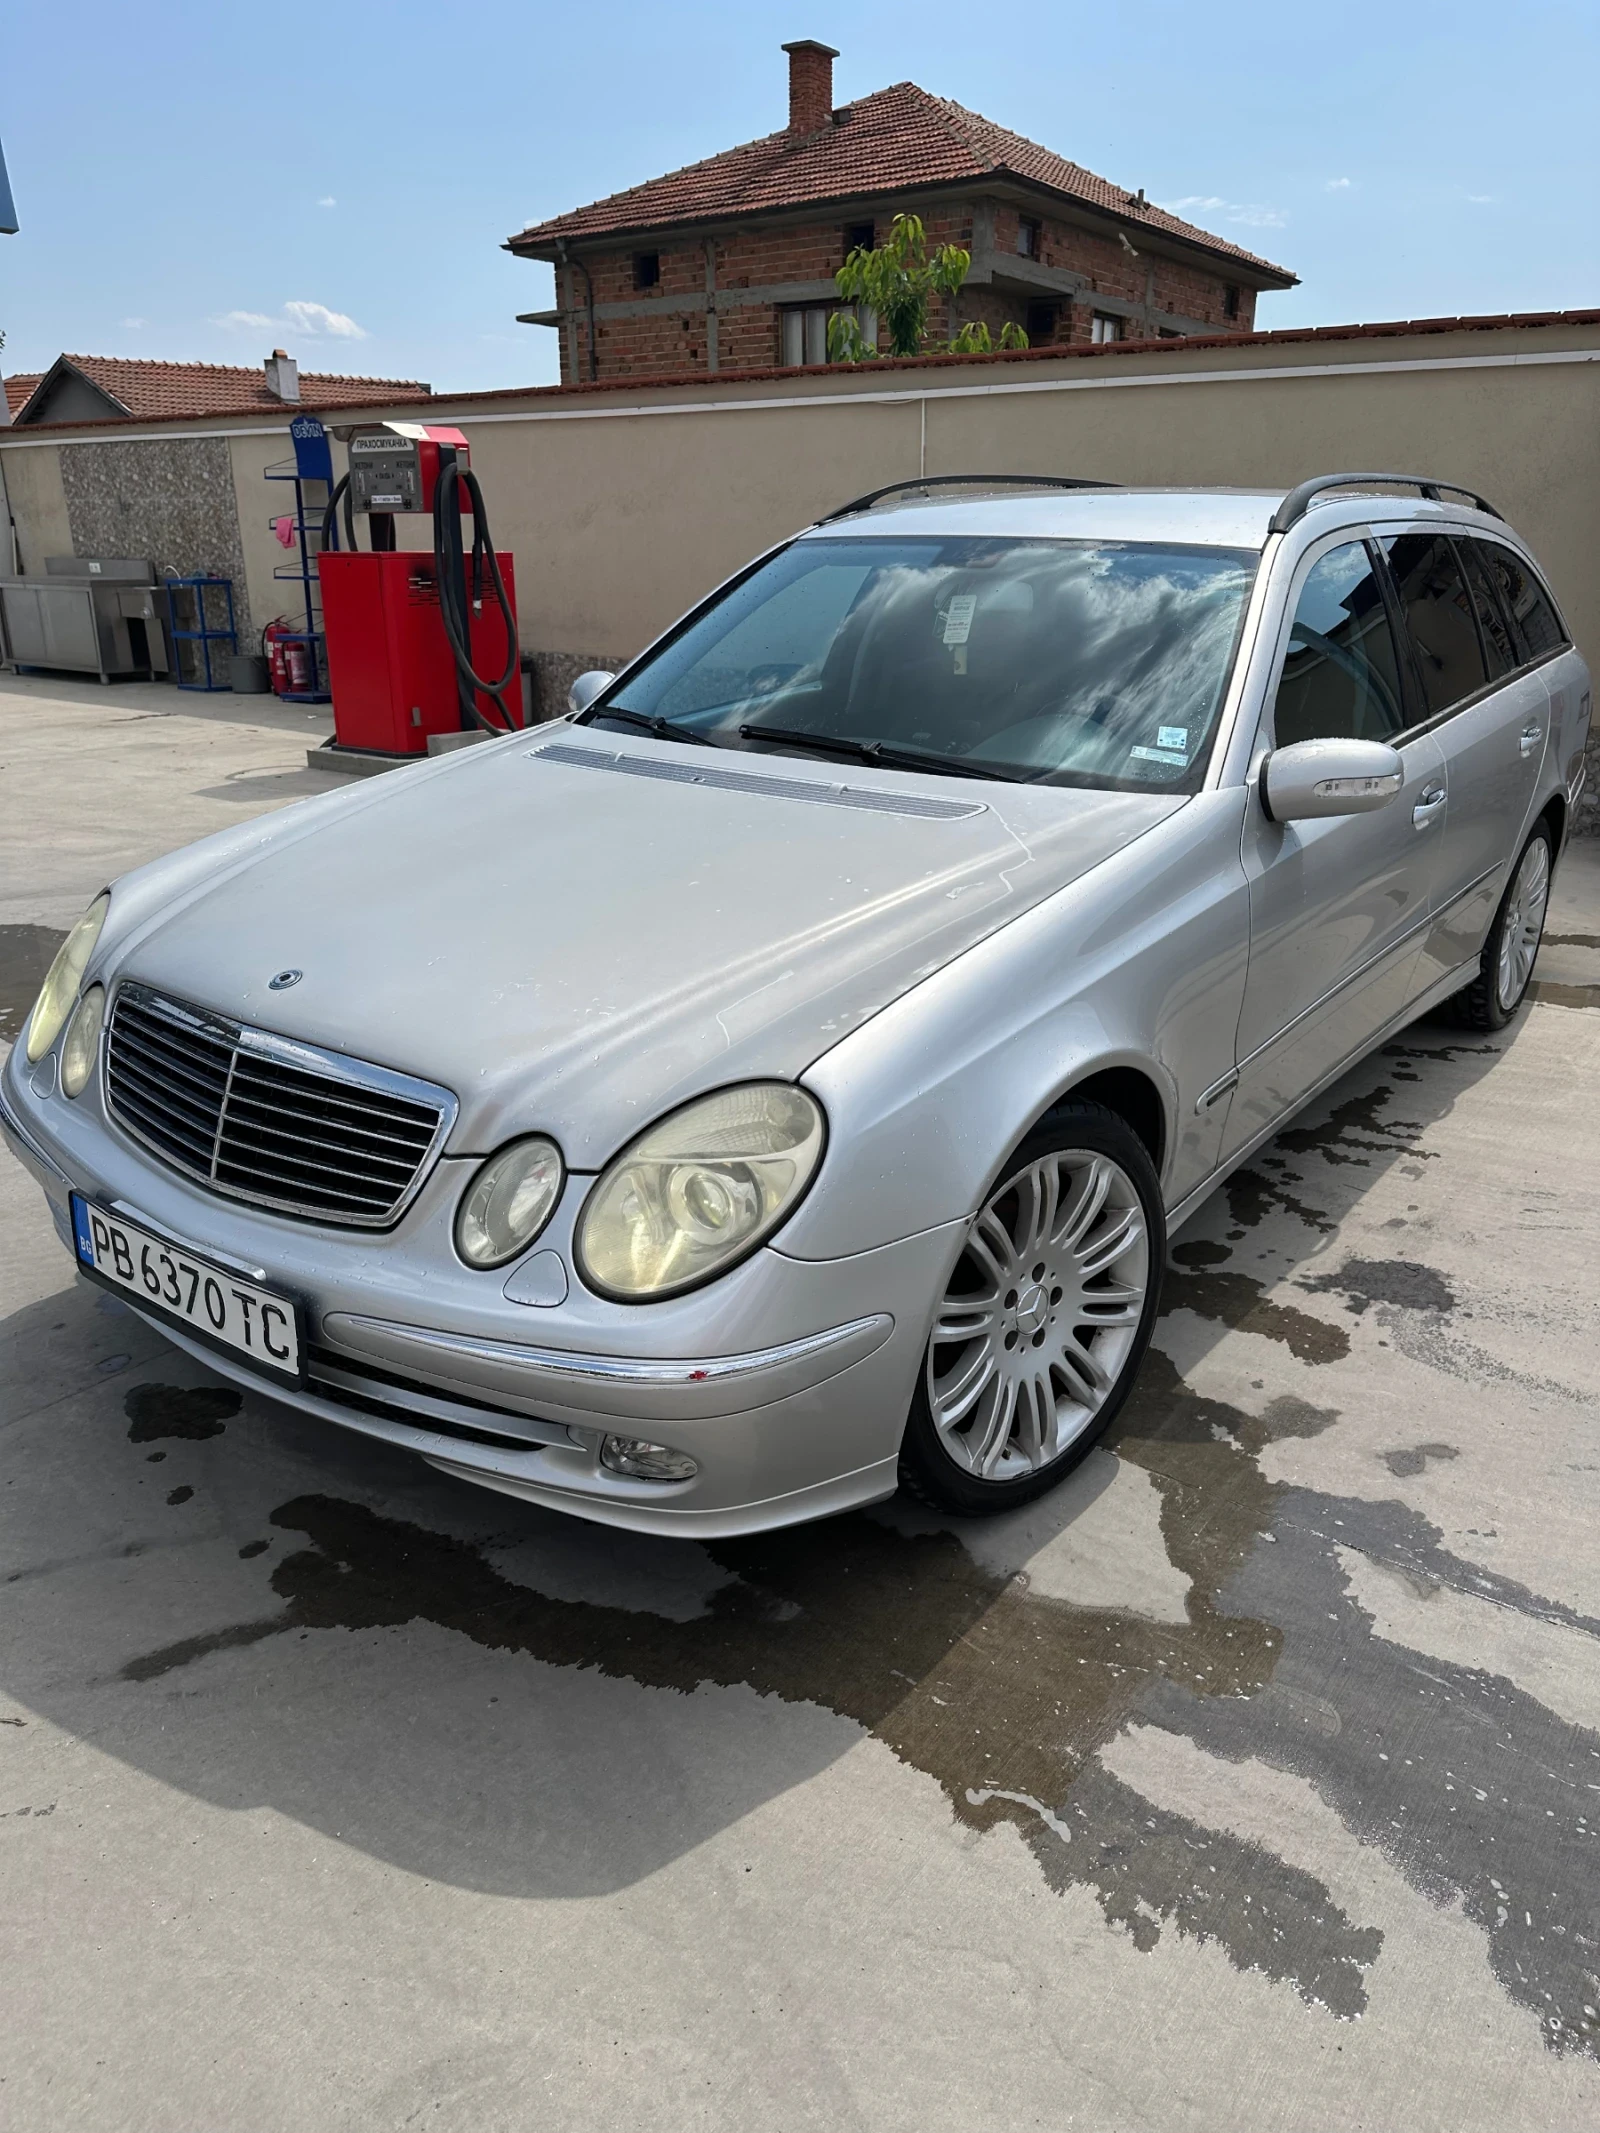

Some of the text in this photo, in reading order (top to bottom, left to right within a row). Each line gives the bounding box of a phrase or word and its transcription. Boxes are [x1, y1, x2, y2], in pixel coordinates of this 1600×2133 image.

[291, 423, 323, 438] DEVIN
[356, 438, 408, 449] ПРАХОСМУКАЧКА
[79, 1235, 92, 1256] BG
[140, 1244, 226, 1330] 6370
